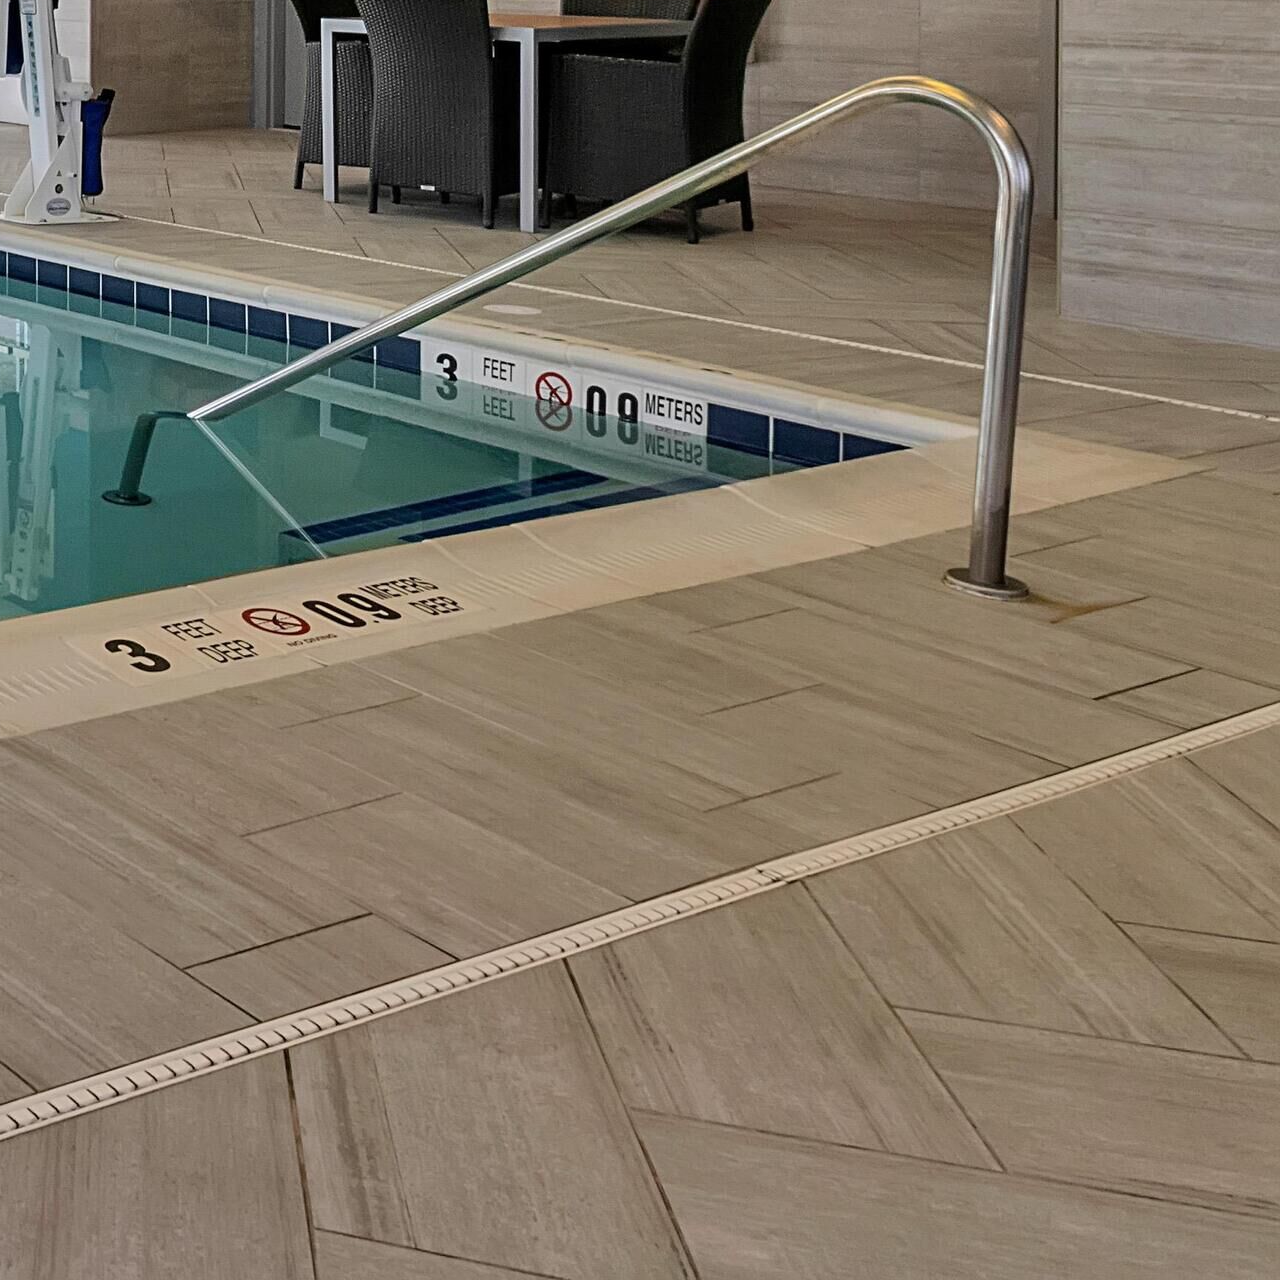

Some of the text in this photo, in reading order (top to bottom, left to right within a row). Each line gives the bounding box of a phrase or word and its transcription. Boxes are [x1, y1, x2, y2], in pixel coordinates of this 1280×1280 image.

[435, 352, 458, 381] 3
[482, 357, 516, 382] FEET
[645, 392, 704, 426] METERS
[359, 576, 439, 601] METERS
[302, 593, 402, 628] 0.9
[408, 596, 465, 617] DEEP
[161, 618, 223, 642] FEET
[287, 633, 338, 648] NO DIVING
[105, 638, 171, 673] 3
[196, 639, 260, 663] DEEP
